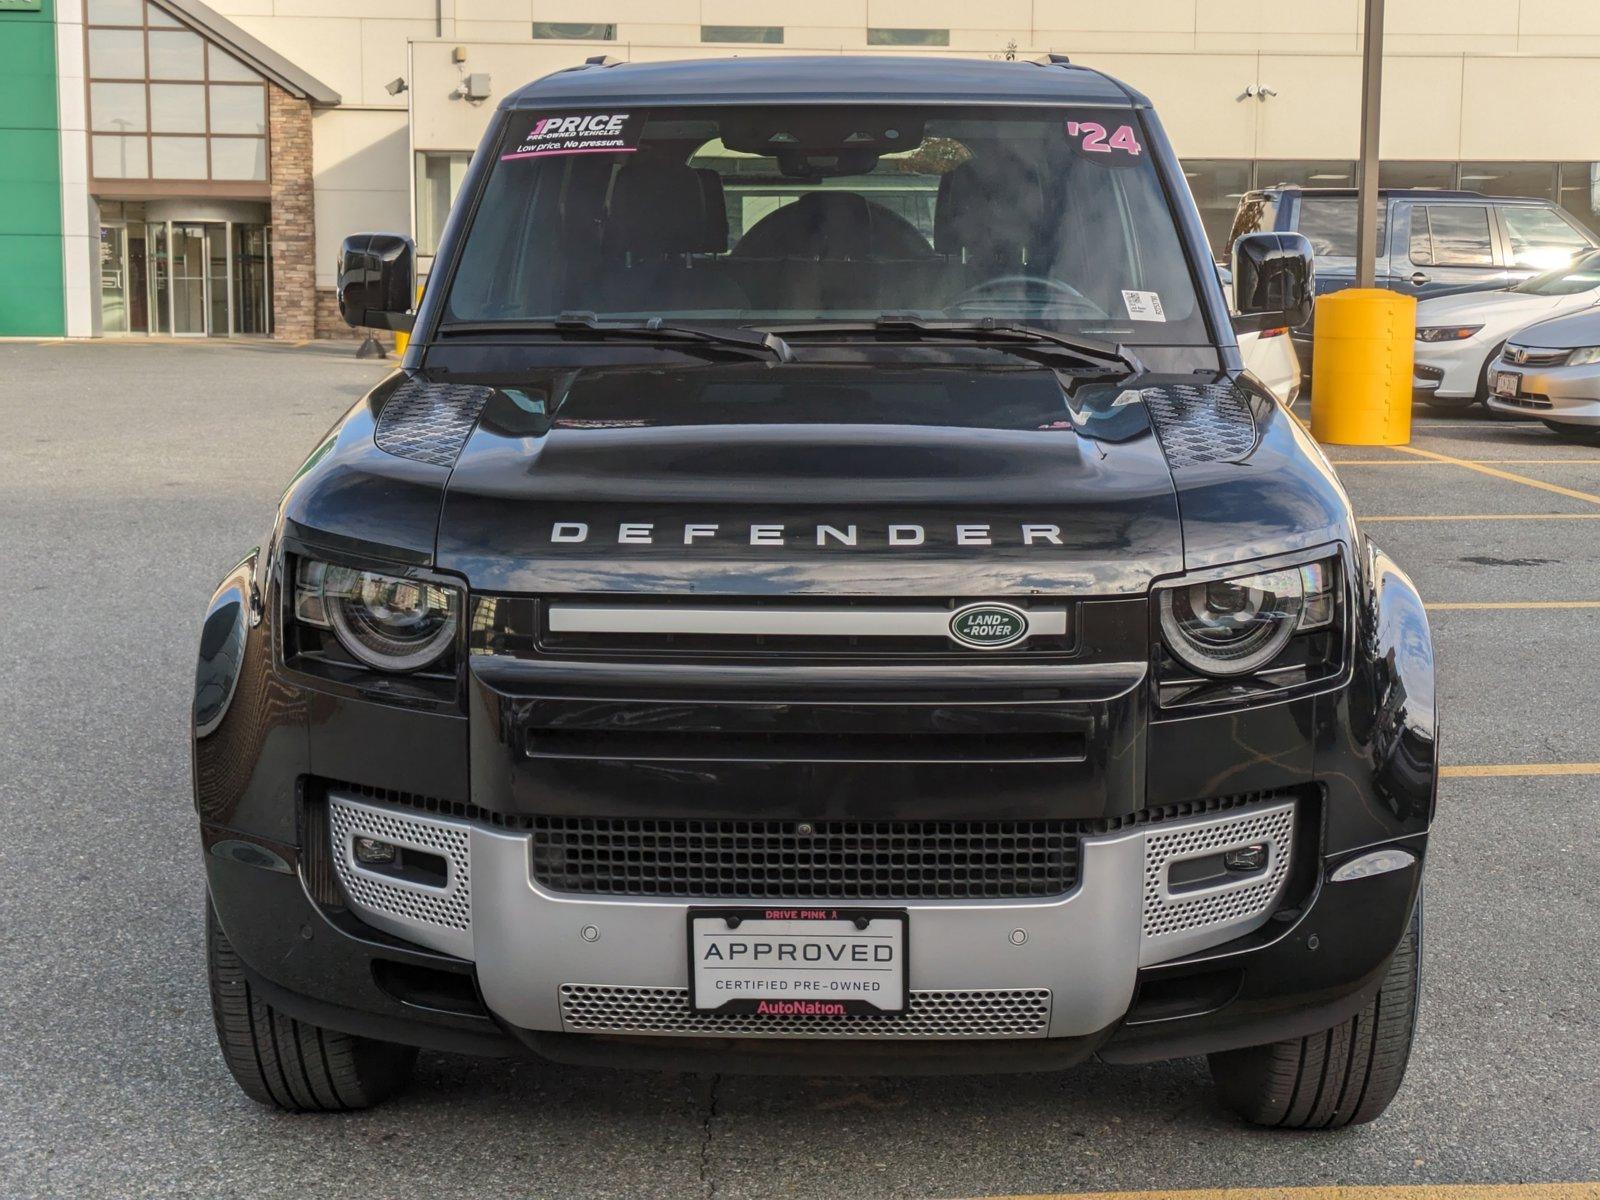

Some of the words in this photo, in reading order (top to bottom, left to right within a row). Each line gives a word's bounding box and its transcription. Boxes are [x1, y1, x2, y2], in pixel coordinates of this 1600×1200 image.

[526, 131, 577, 141] PRE-OWNED
[1067, 121, 1142, 155] '24
[516, 145, 535, 153] Low
[536, 142, 560, 151] price.
[563, 140, 579, 148] No
[578, 139, 624, 149] pressure.
[550, 522, 1064, 547] DEFENDER
[765, 910, 798, 919] DRIVE
[801, 911, 826, 919] PINK
[703, 943, 893, 962] APPROVED
[715, 980, 788, 990] CERTIFIED
[794, 981, 881, 991] PRE-OWNED
[757, 1001, 844, 1015] AutoNation
